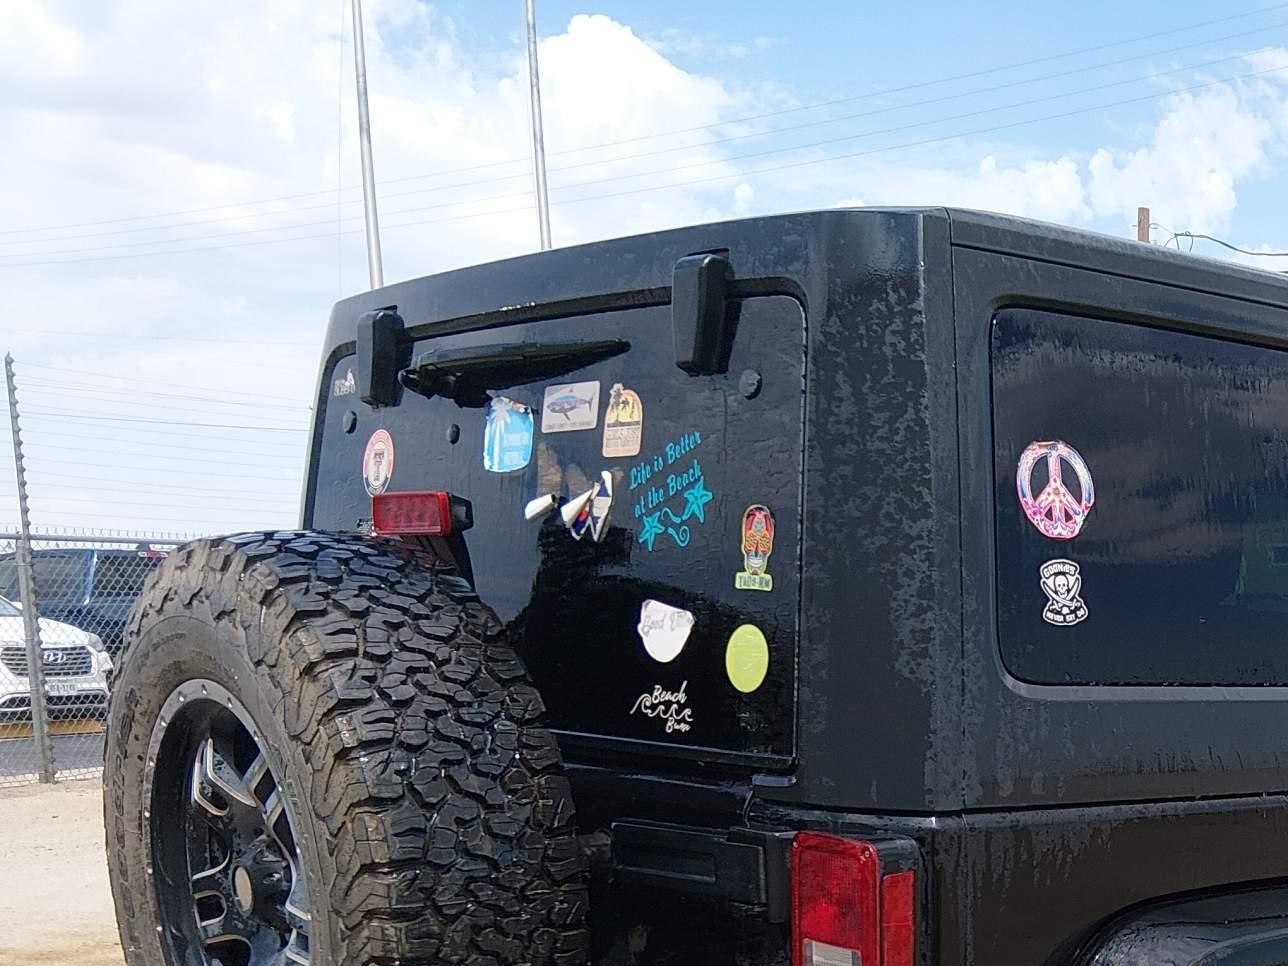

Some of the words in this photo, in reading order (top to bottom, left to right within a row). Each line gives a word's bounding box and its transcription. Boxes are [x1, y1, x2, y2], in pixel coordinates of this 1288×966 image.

[629, 462, 652, 490] Life
[653, 455, 664, 474] is
[665, 431, 702, 465] Better
[634, 496, 646, 518] at
[648, 486, 665, 509] the
[666, 458, 702, 497] Beach
[651, 679, 688, 704] Beach
